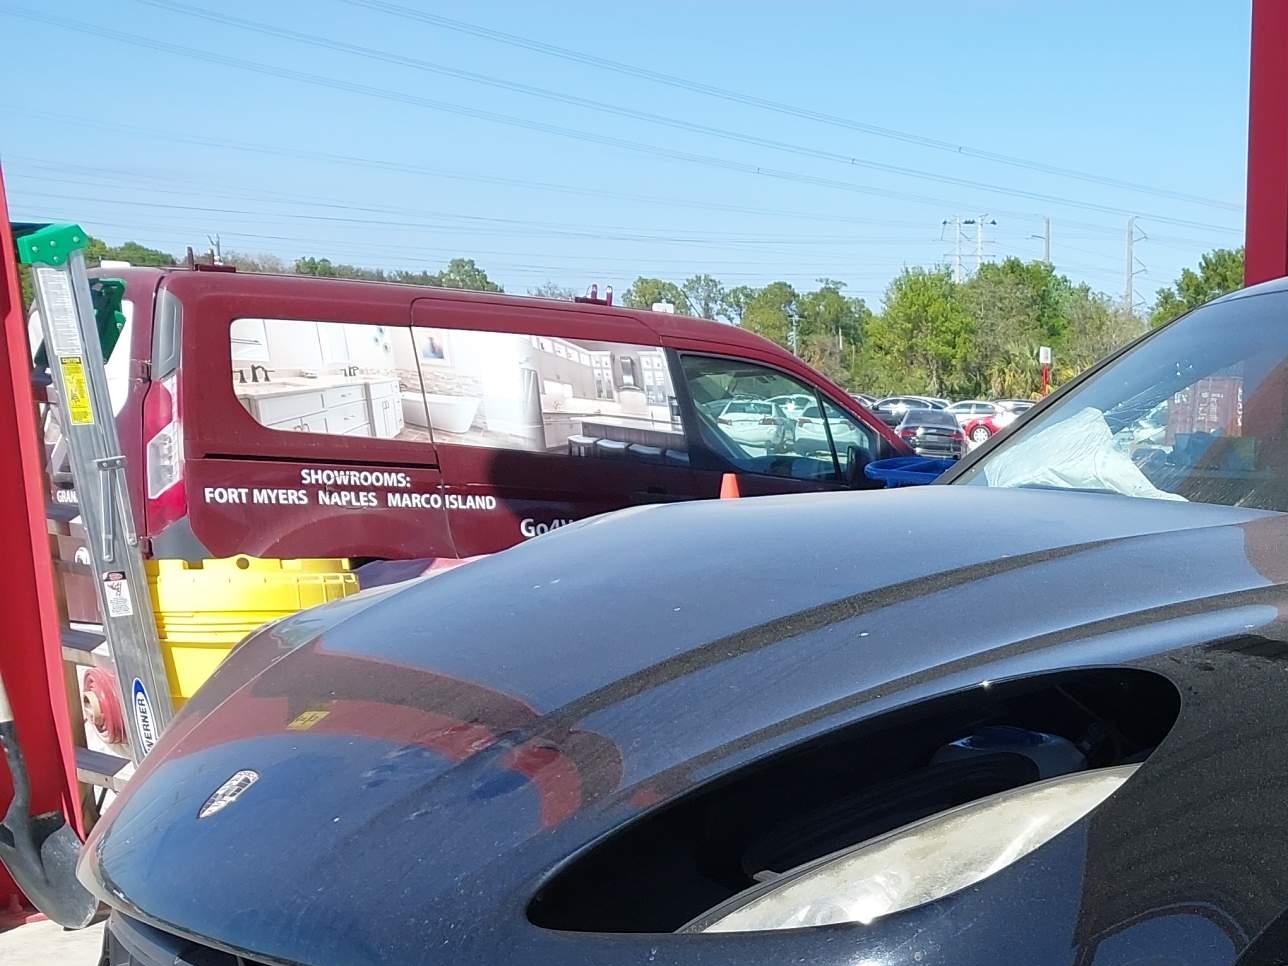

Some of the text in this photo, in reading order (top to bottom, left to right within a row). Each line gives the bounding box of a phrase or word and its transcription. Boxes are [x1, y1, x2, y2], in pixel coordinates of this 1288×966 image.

[301, 469, 411, 488] SHOWROOMS:
[56, 490, 79, 503] GRAN
[204, 487, 497, 510] FORT MYERS NAPLES MARCO ISLAND
